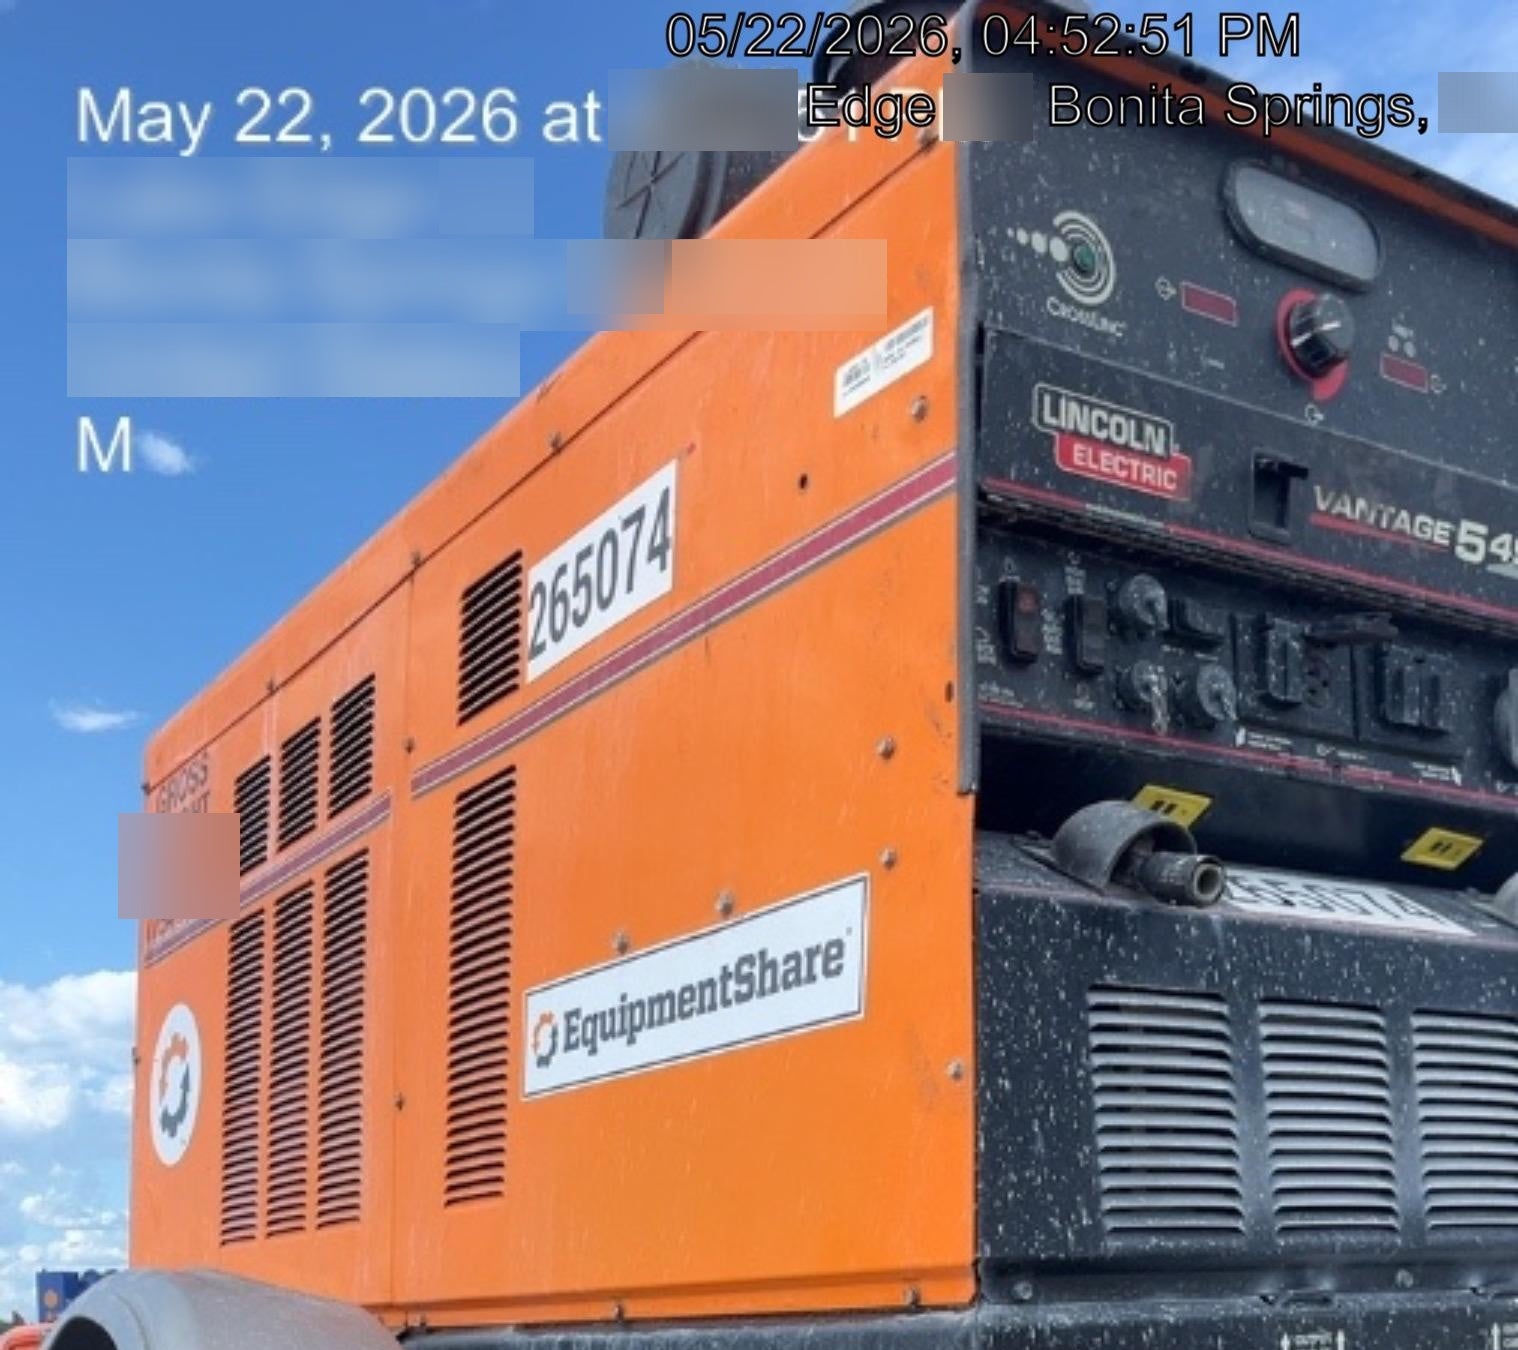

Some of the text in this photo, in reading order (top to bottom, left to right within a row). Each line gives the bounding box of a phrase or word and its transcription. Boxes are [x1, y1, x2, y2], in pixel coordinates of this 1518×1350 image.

[1042, 393, 1167, 458] LINCOLN
[1072, 443, 1178, 490] ELECTRIC
[1313, 485, 1518, 565] VANTAGE 54
[529, 486, 670, 662] 265074
[562, 936, 846, 1057] EquipmentShare
